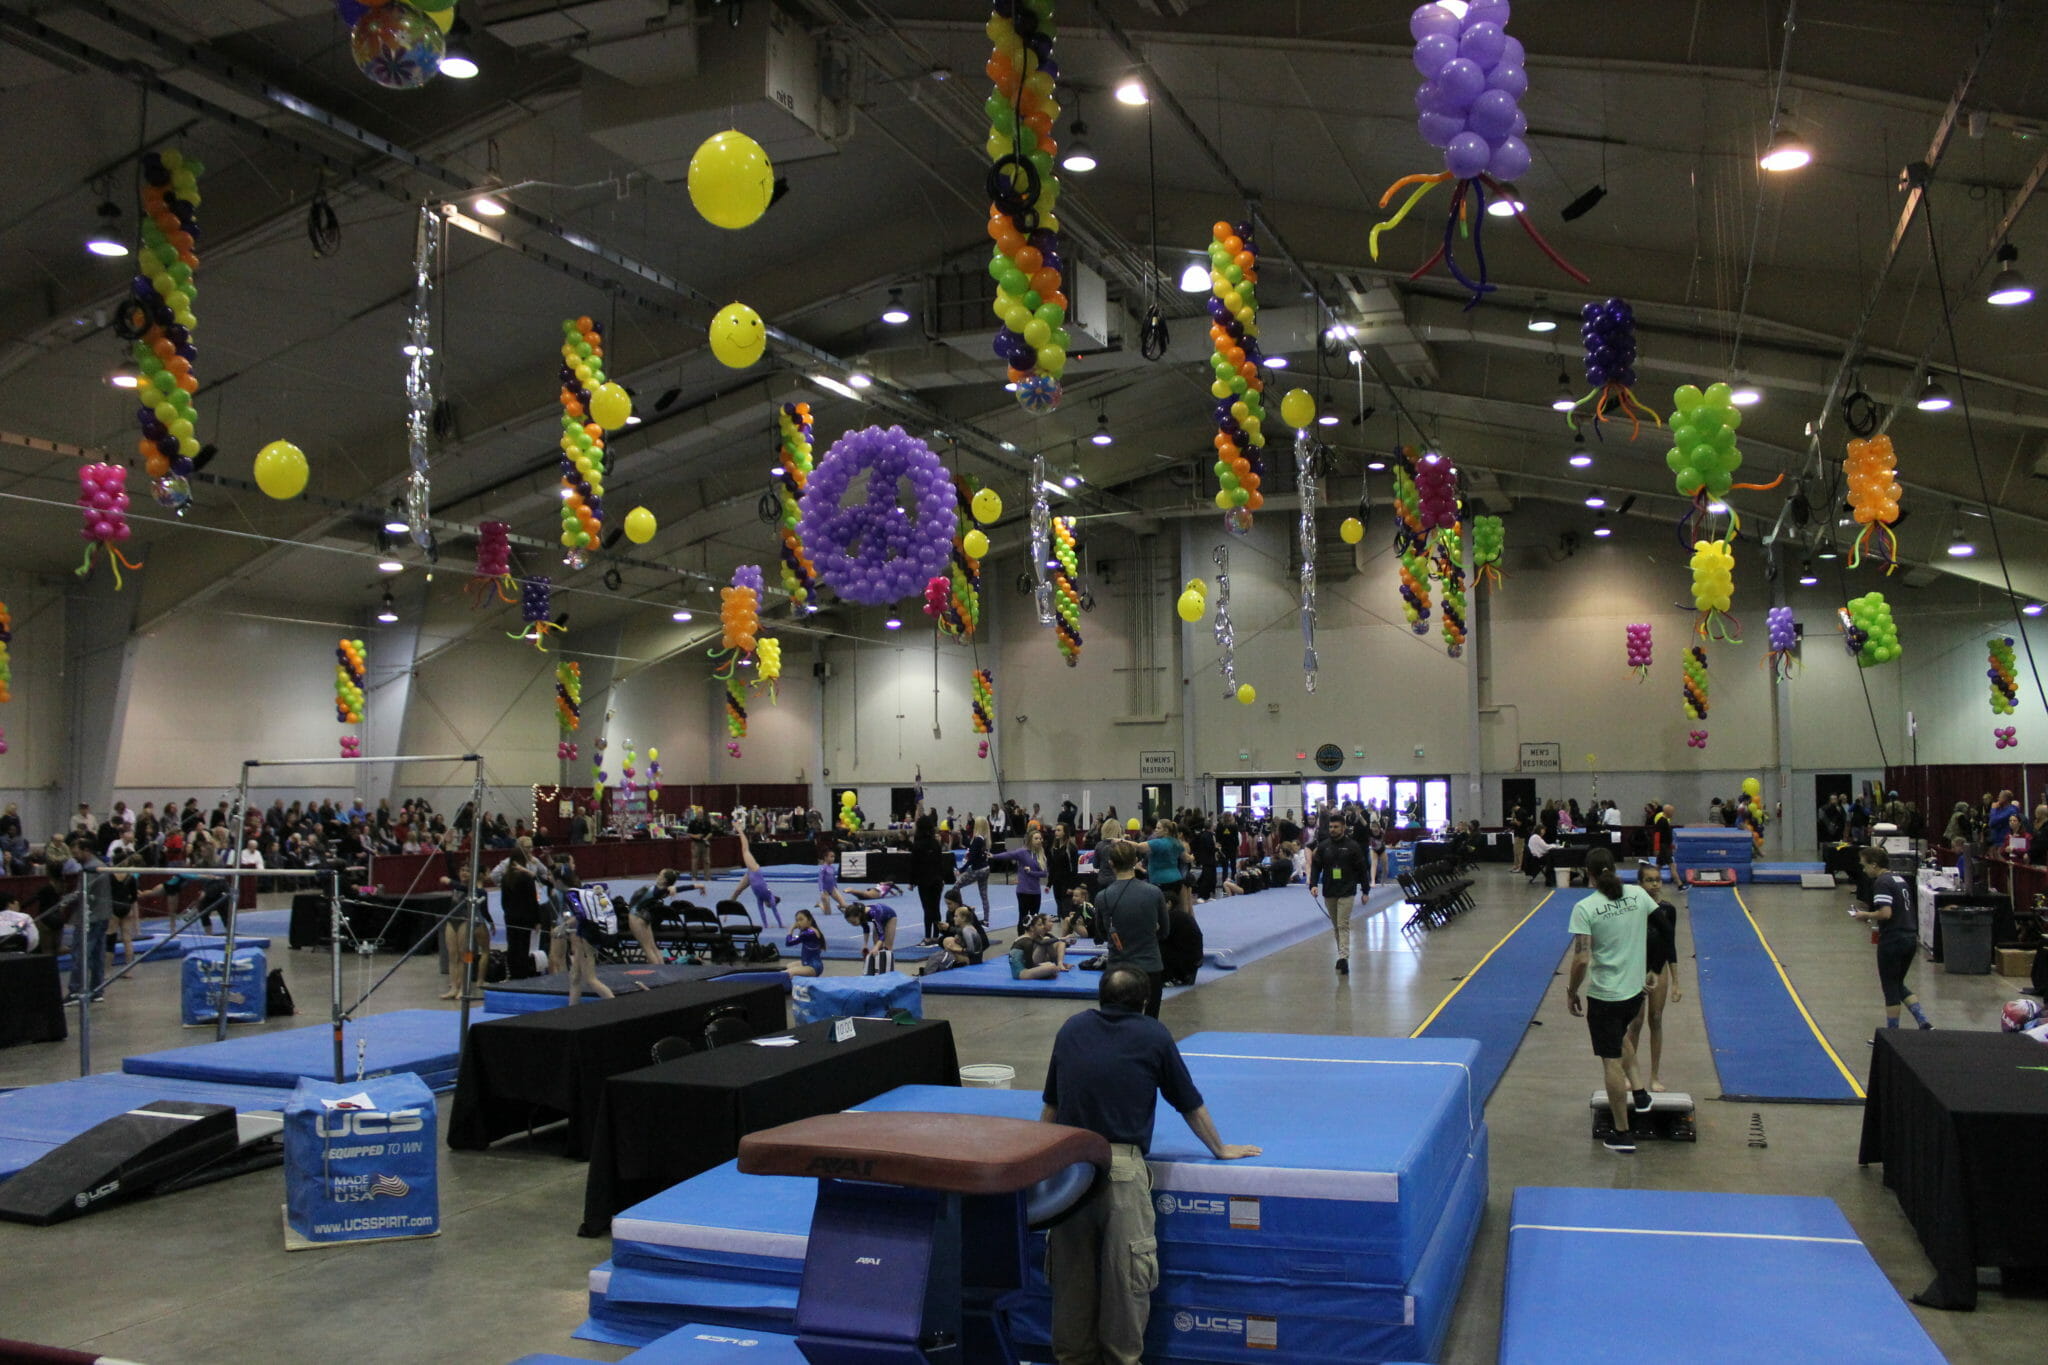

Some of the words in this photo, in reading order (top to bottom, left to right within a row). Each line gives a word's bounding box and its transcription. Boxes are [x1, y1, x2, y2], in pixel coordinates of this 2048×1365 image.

[1142, 766, 1174, 774] RESTROOM
[1595, 895, 1639, 916] UNITY
[316, 1108, 423, 1138] UCS
[387, 1142, 401, 1155] TO
[402, 1141, 423, 1154] WIN
[334, 1175, 369, 1185] MADE
[88, 1179, 121, 1201] UCS
[335, 1185, 347, 1193] IN
[348, 1184, 370, 1193] THE
[335, 1192, 374, 1203] USA
[1177, 1198, 1226, 1212] UCS
[314, 1216, 432, 1233] www.UCSSPIRIT.com
[1195, 1315, 1243, 1330] UCS
